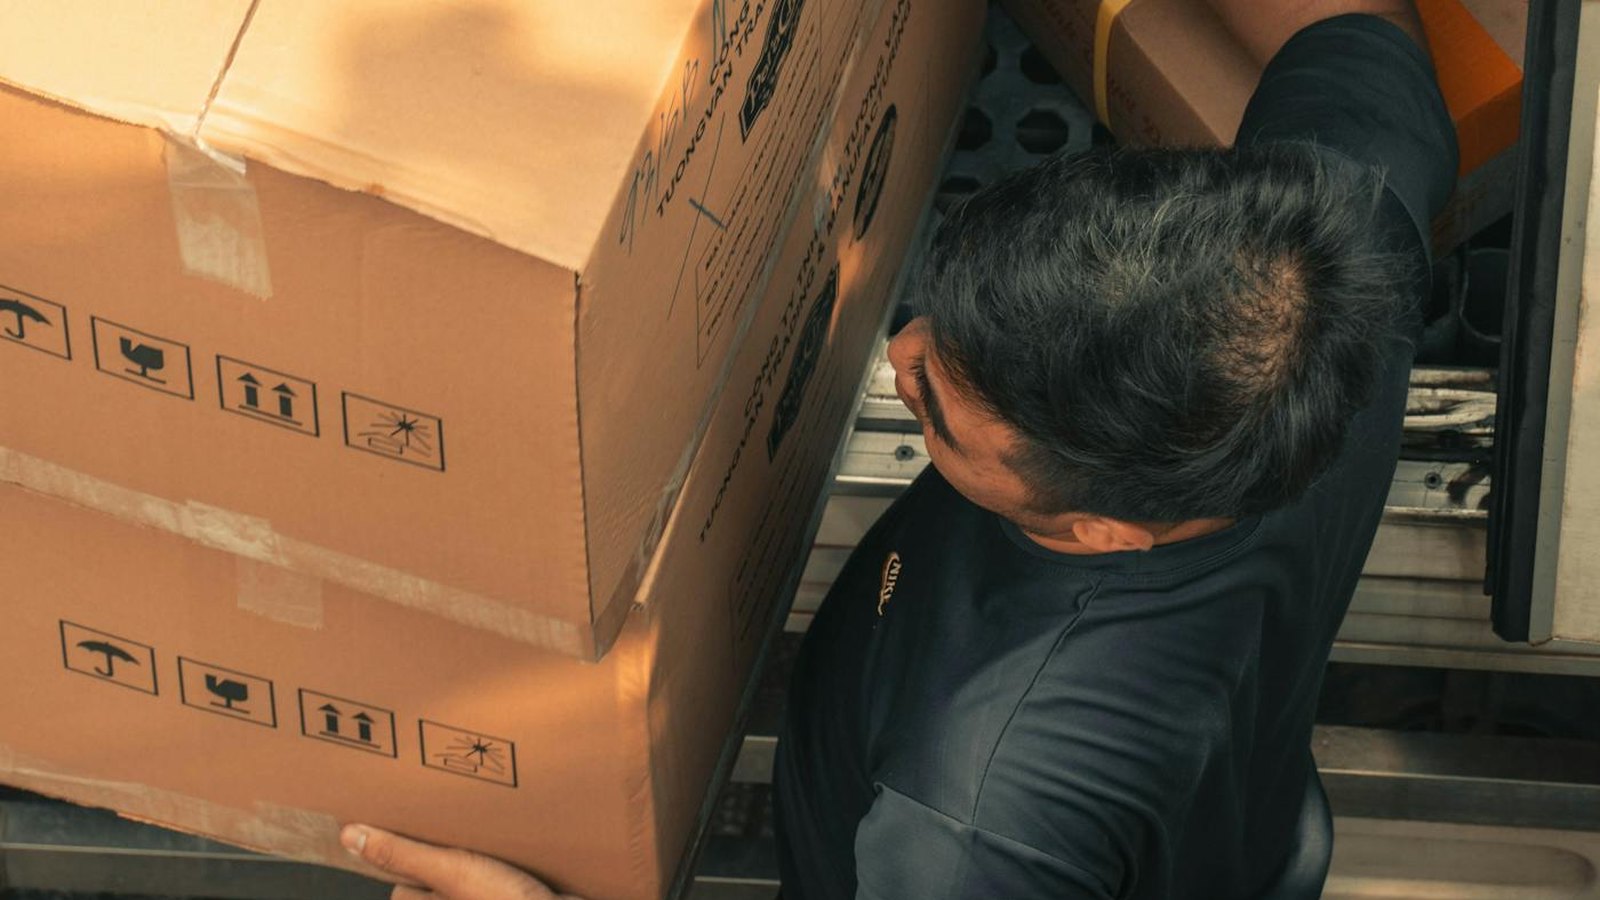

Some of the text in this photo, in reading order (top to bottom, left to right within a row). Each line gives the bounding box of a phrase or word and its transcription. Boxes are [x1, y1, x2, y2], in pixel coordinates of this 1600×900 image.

[656, 61, 732, 218] TUONGVAN
[735, 0, 766, 57] TRA
[700, 393, 764, 542] TUONGVAN
[766, 265, 815, 388] TRADING
